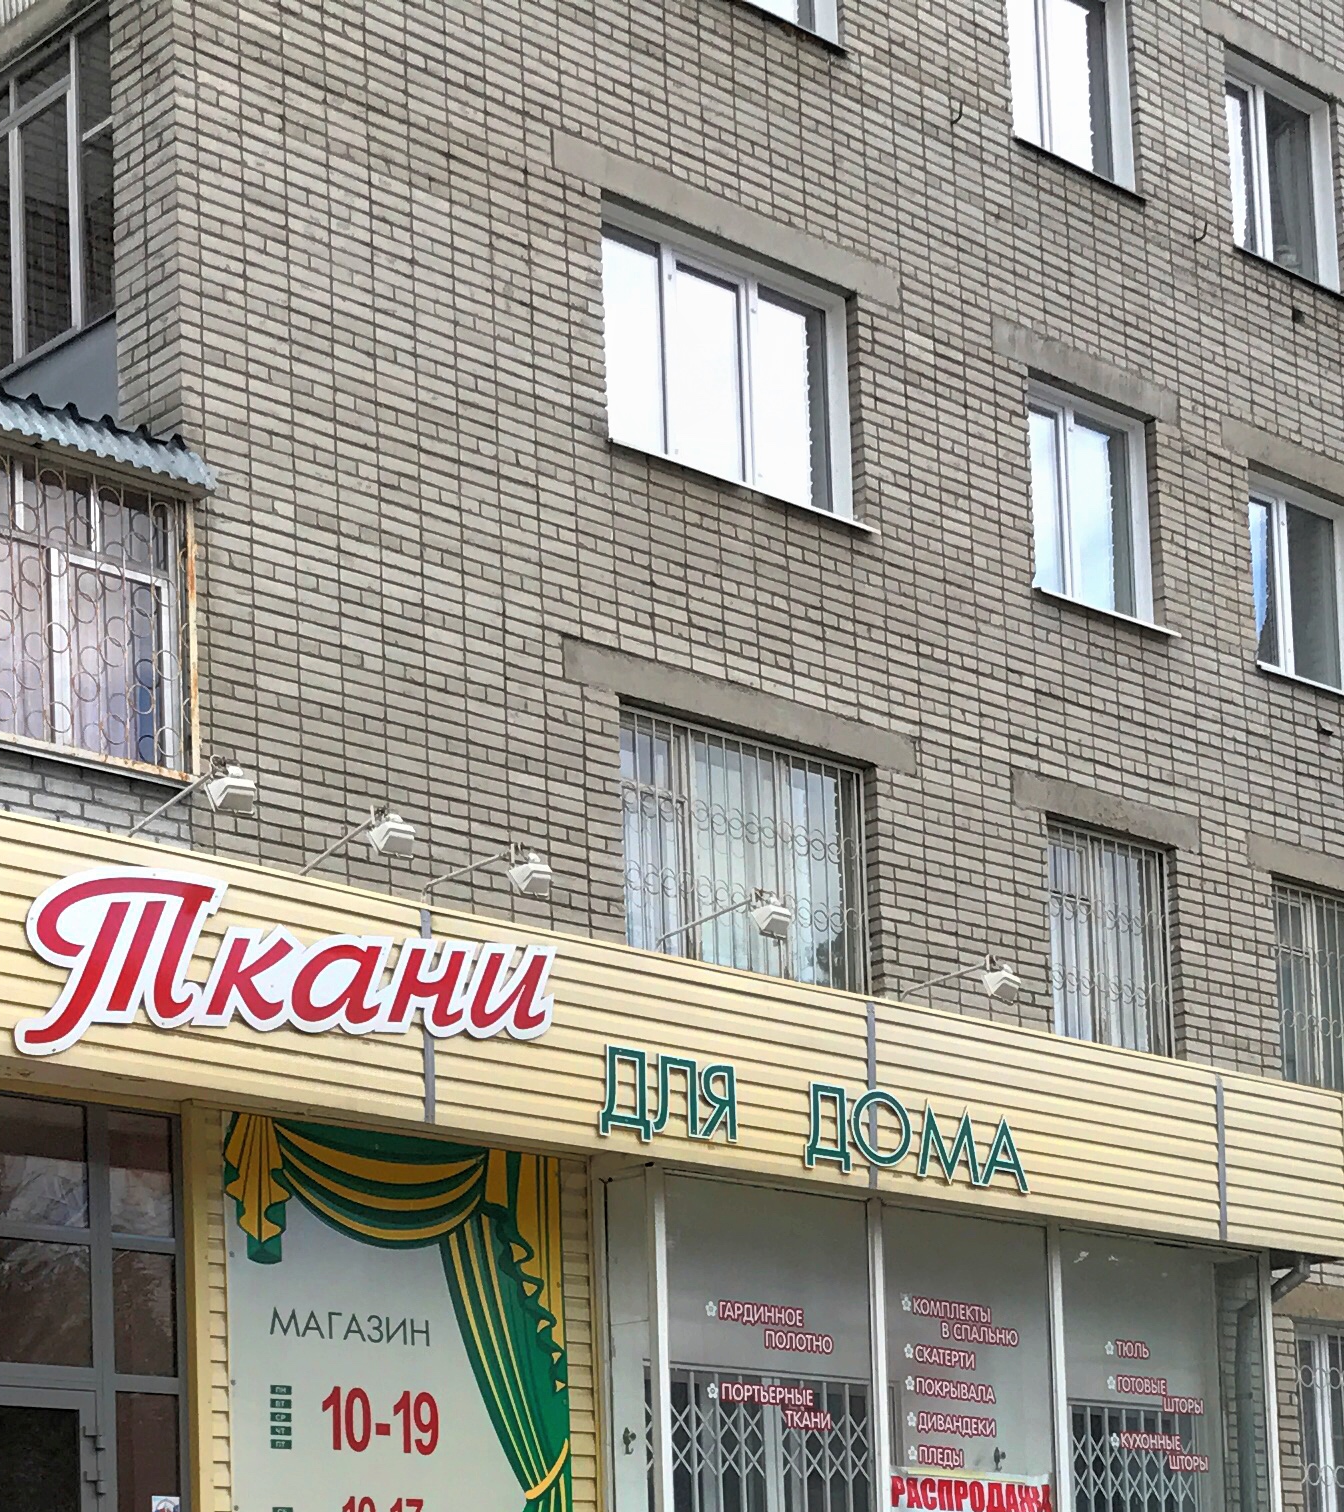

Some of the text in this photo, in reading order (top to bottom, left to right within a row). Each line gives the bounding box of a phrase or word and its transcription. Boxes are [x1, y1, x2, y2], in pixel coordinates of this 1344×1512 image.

[23, 875, 549, 1045] Ткани
[599, 1043, 1031, 1194] ДЛЯ ДОМА
[717, 1300, 805, 1328] ГАРДИННОЕ
[912, 1296, 992, 1324] КОМПЛЕКТЫ
[269, 1306, 431, 1347] МАГАЗИН
[941, 1321, 1020, 1347] В СПАЛЬНЮ
[763, 1329, 834, 1354] ПОЛОТНО
[1115, 1339, 1151, 1360] ТЮЛЬ
[914, 1344, 977, 1371] СКАТЕРТИ
[720, 1382, 814, 1408] ПОРТЬЕРНЫЕ
[915, 1377, 997, 1404] ПОКРЫВАЛА
[1116, 1375, 1168, 1396] ГОТОВЫЕ
[1162, 1395, 1205, 1416] ШТОРЫ
[321, 1385, 440, 1456] 10-19
[784, 1408, 833, 1431] ТКАНИ
[917, 1411, 998, 1438] ДИВАНДЕКИ
[1120, 1431, 1182, 1452] КУХОННЫЕ
[918, 1445, 966, 1470] ПЛЕДЫ
[1168, 1452, 1210, 1472] ШТОРЫ
